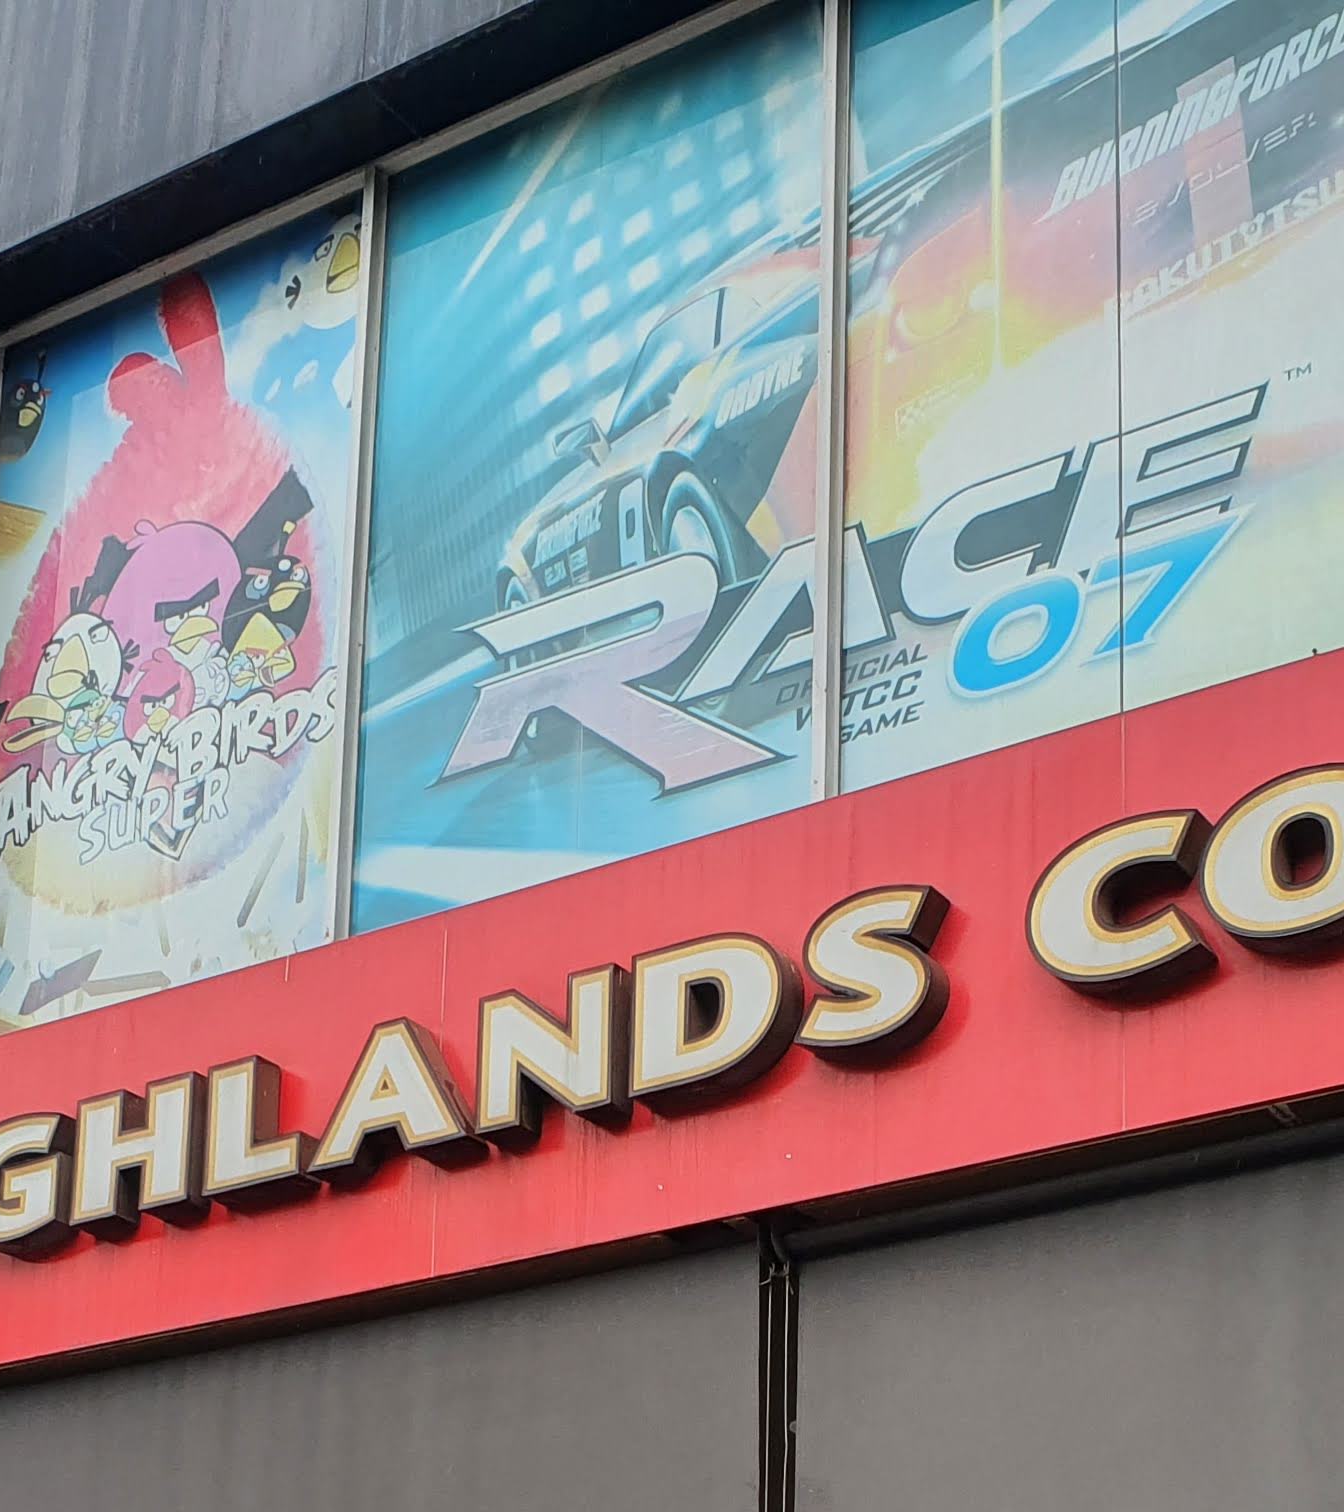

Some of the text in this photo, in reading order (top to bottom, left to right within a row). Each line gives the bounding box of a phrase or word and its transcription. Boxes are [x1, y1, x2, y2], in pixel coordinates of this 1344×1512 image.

[424, 380, 1272, 803] RACE
[948, 503, 1256, 699] 07
[163, 666, 339, 780] BIRDS
[79, 768, 230, 865] SUPER
